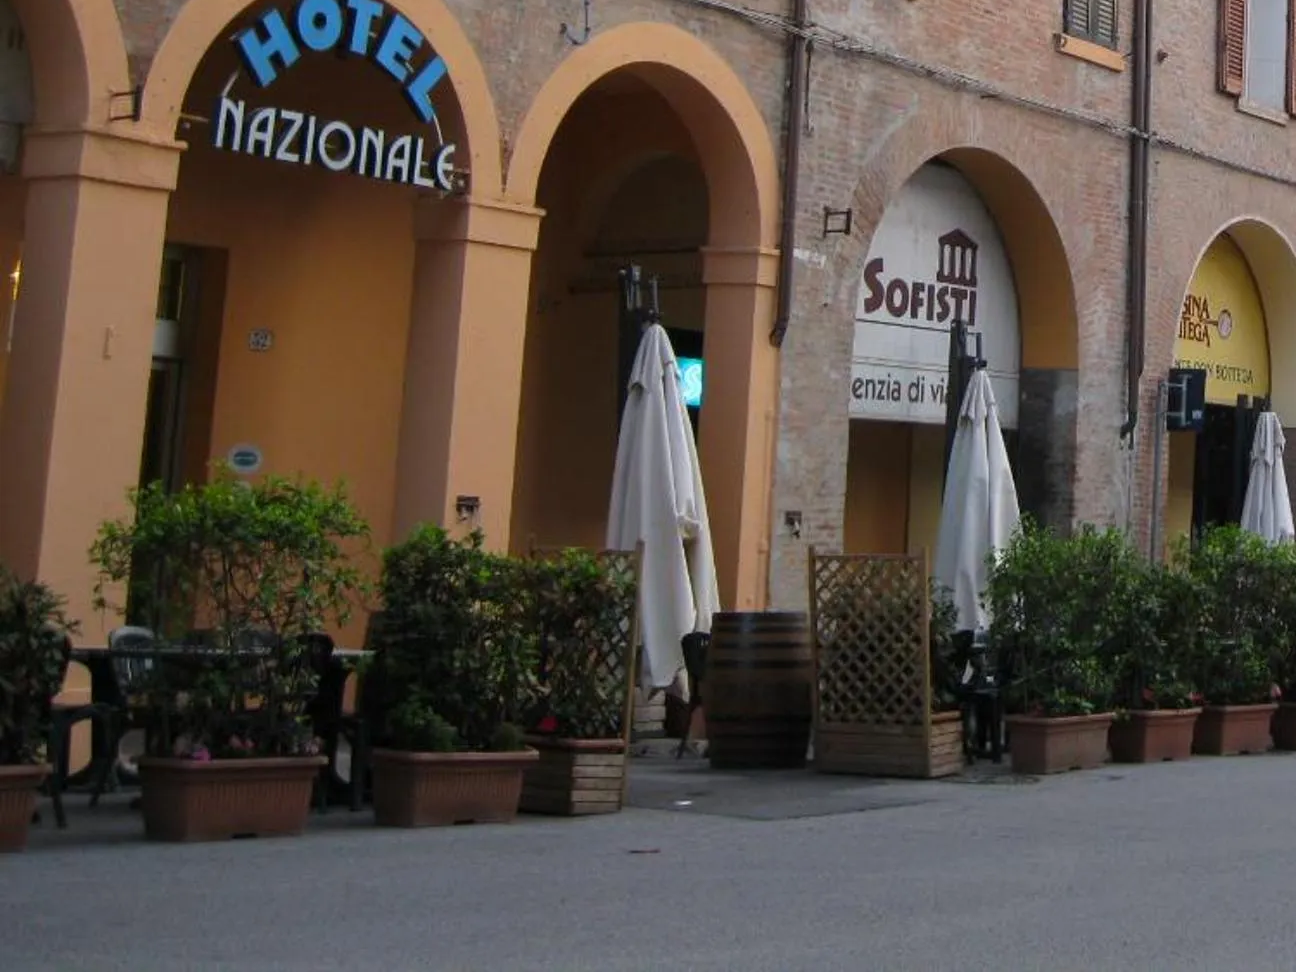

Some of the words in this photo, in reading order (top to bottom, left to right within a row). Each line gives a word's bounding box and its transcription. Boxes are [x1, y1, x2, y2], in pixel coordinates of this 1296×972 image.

[215, 95, 456, 191] NAZIONALE
[863, 258, 978, 326] SOFISTI
[908, 375, 925, 403] di
